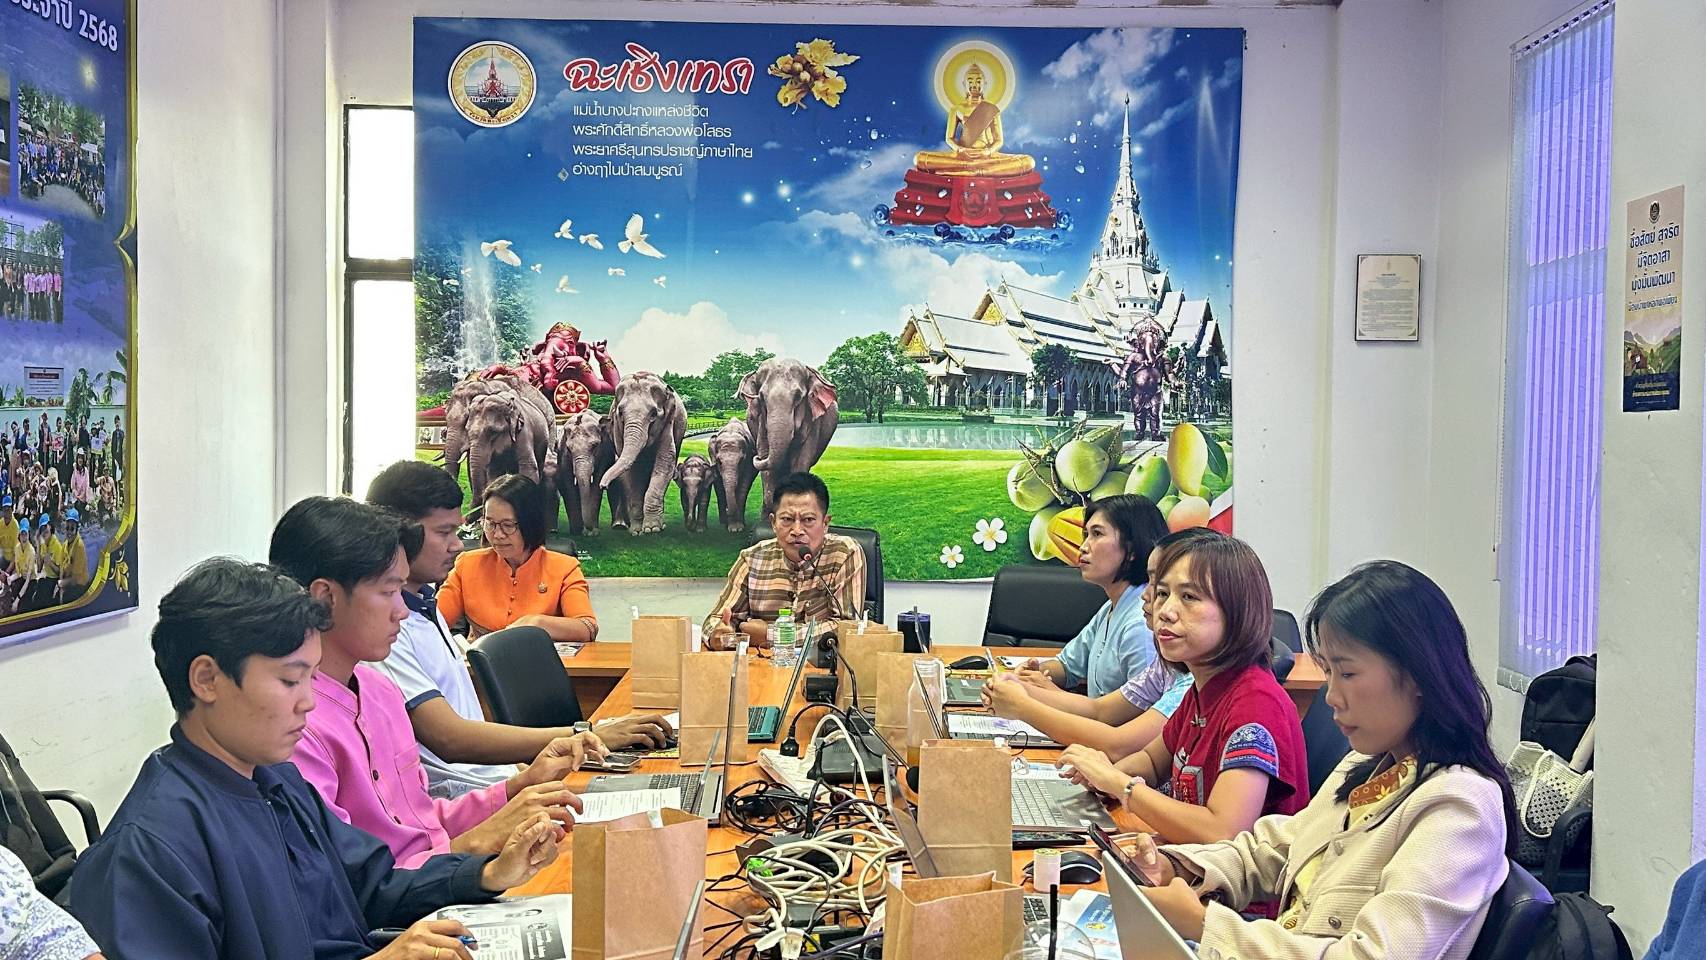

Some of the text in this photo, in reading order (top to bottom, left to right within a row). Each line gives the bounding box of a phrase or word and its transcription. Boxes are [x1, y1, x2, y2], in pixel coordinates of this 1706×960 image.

[79, 9, 118, 51] 2568
[563, 42, 755, 95] ฉะเชิงเทรา
[573, 100, 709, 118] แม่น้ำบางปะกงแหล่งชีวิต
[573, 121, 732, 138] พระศักดิ์สิทธิ์หลวงพ่อโสธร
[573, 142, 753, 160] พระยาศรีสุนทรปราชญ์ภาษาไทย
